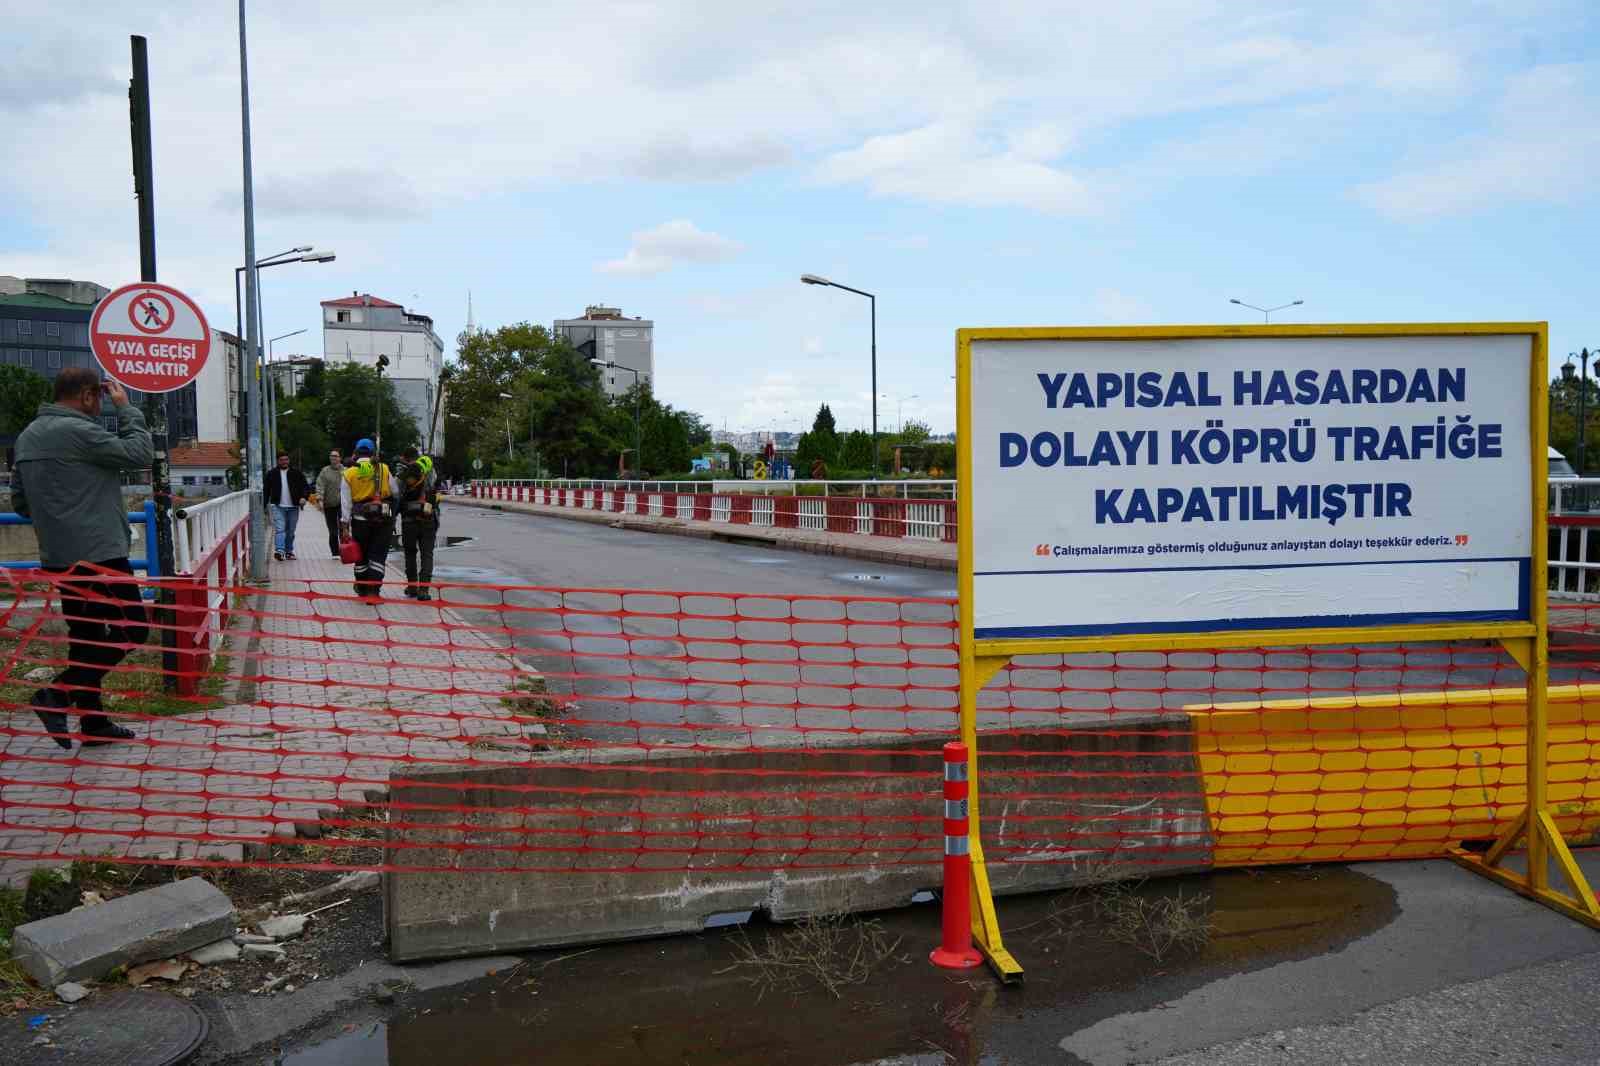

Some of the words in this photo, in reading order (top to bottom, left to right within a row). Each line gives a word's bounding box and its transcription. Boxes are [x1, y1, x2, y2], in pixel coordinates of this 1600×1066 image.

[106, 340, 146, 356] YAYA
[149, 343, 196, 361] GEÇİŞİ
[116, 359, 189, 377] YASAKTIR
[1036, 372, 1222, 409] YAPISAL
[1233, 367, 1466, 406] HASARDAN
[999, 430, 1159, 468] DOLAYI
[1171, 418, 1317, 465] KÖPRÜ
[1326, 414, 1503, 462] TRAFİĞE
[1095, 482, 1413, 527] KAPATILMIŞTIR
[1147, 542, 1205, 556] göstermiş
[1208, 540, 1268, 554] olduğunuz
[1270, 539, 1327, 552] anlayıştan
[1329, 537, 1363, 551] dolayı
[1365, 536, 1413, 550] teşekkür
